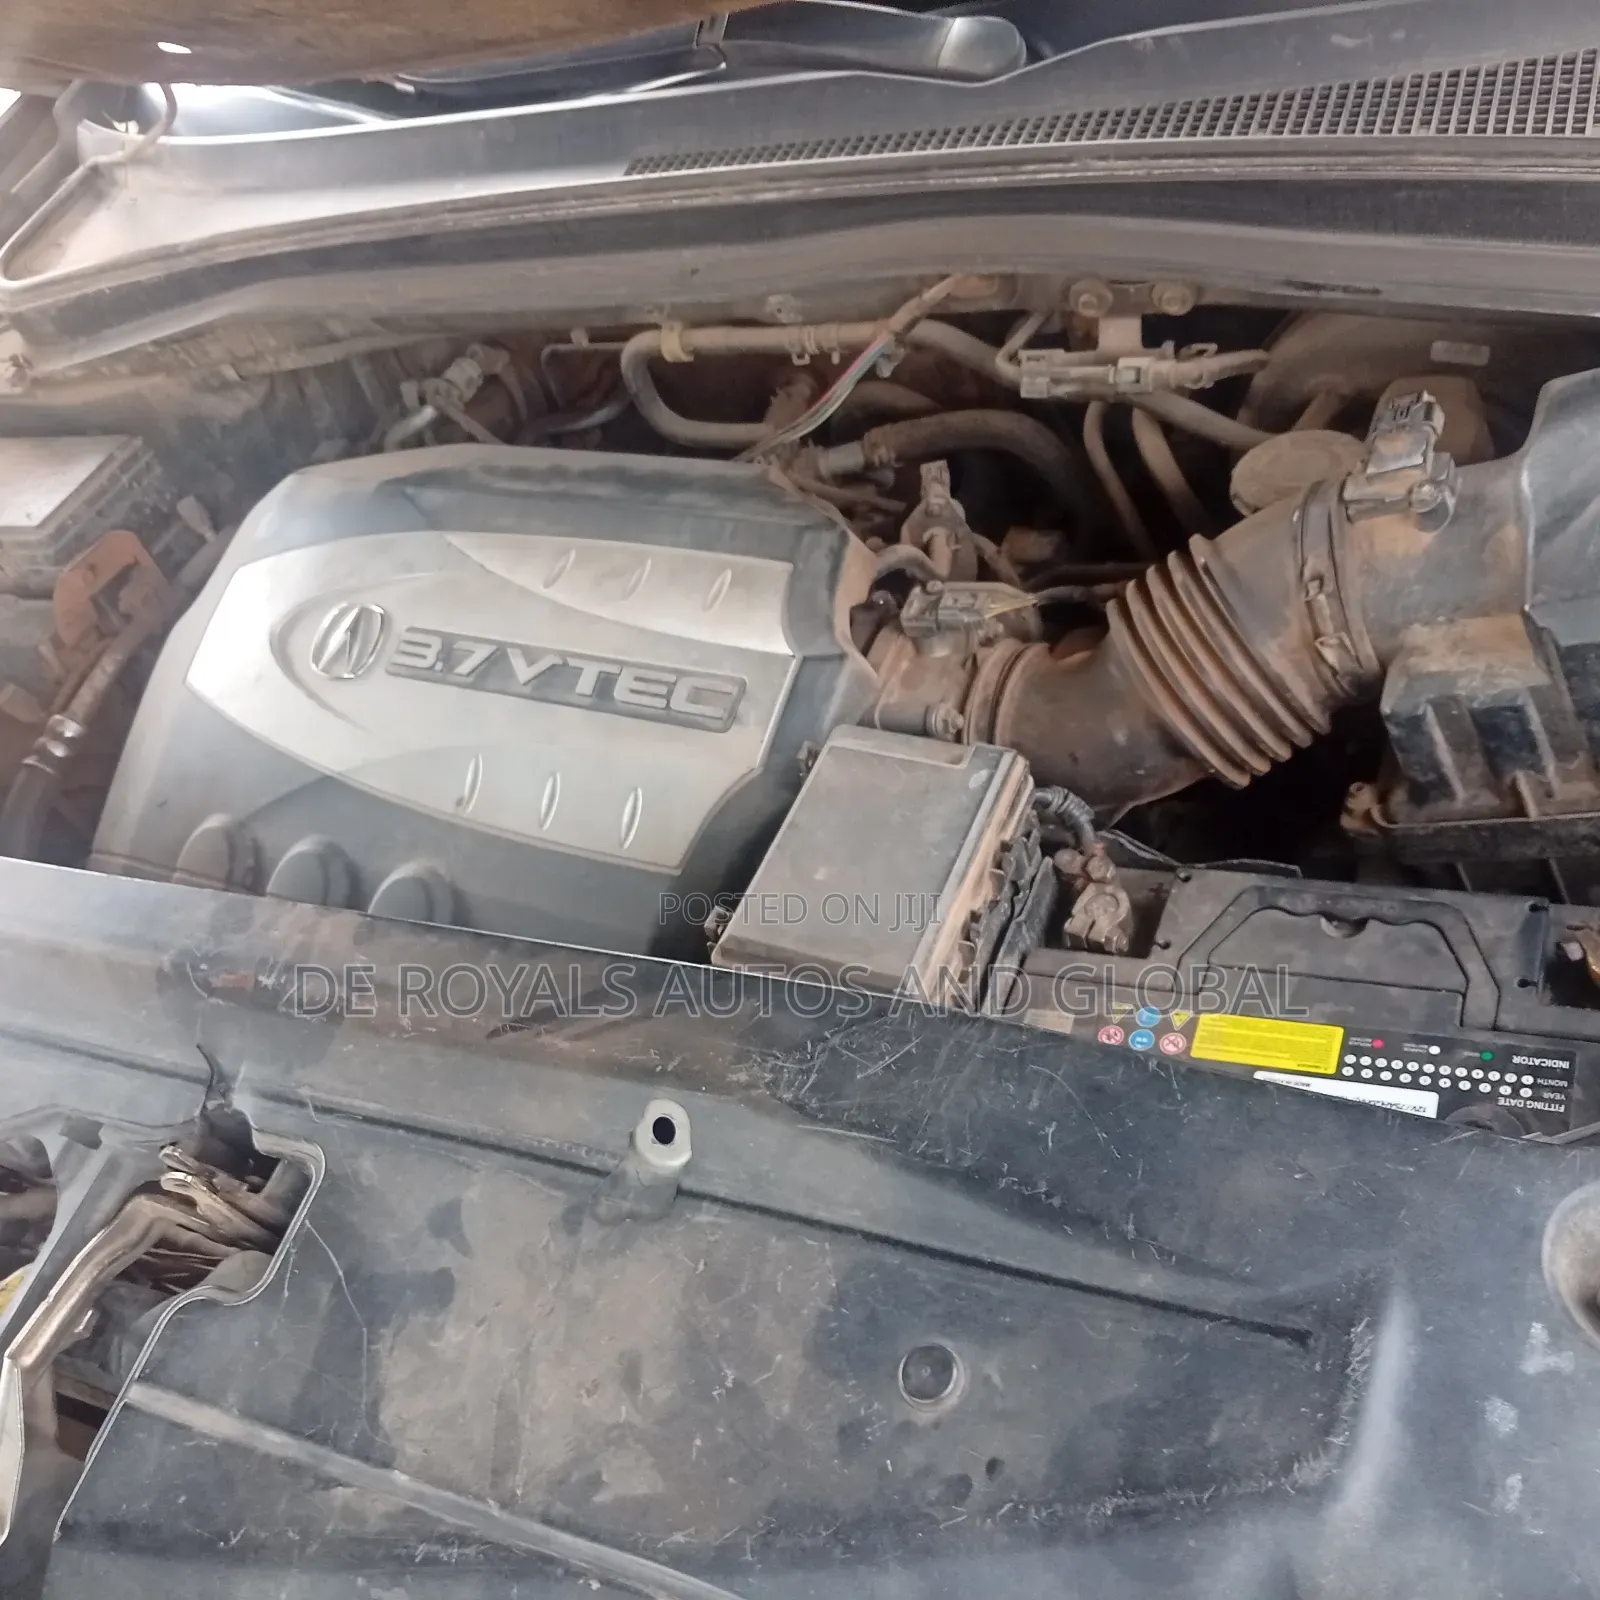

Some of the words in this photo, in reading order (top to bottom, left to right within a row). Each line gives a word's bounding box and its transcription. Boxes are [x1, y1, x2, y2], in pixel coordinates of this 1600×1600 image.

[393, 631, 499, 677] 3.7
[507, 648, 735, 719] VTEC
[1512, 1054, 1570, 1069] INDICATOR
[1497, 1096, 1525, 1108] DATE
[1527, 1100, 1565, 1112] FITTING
